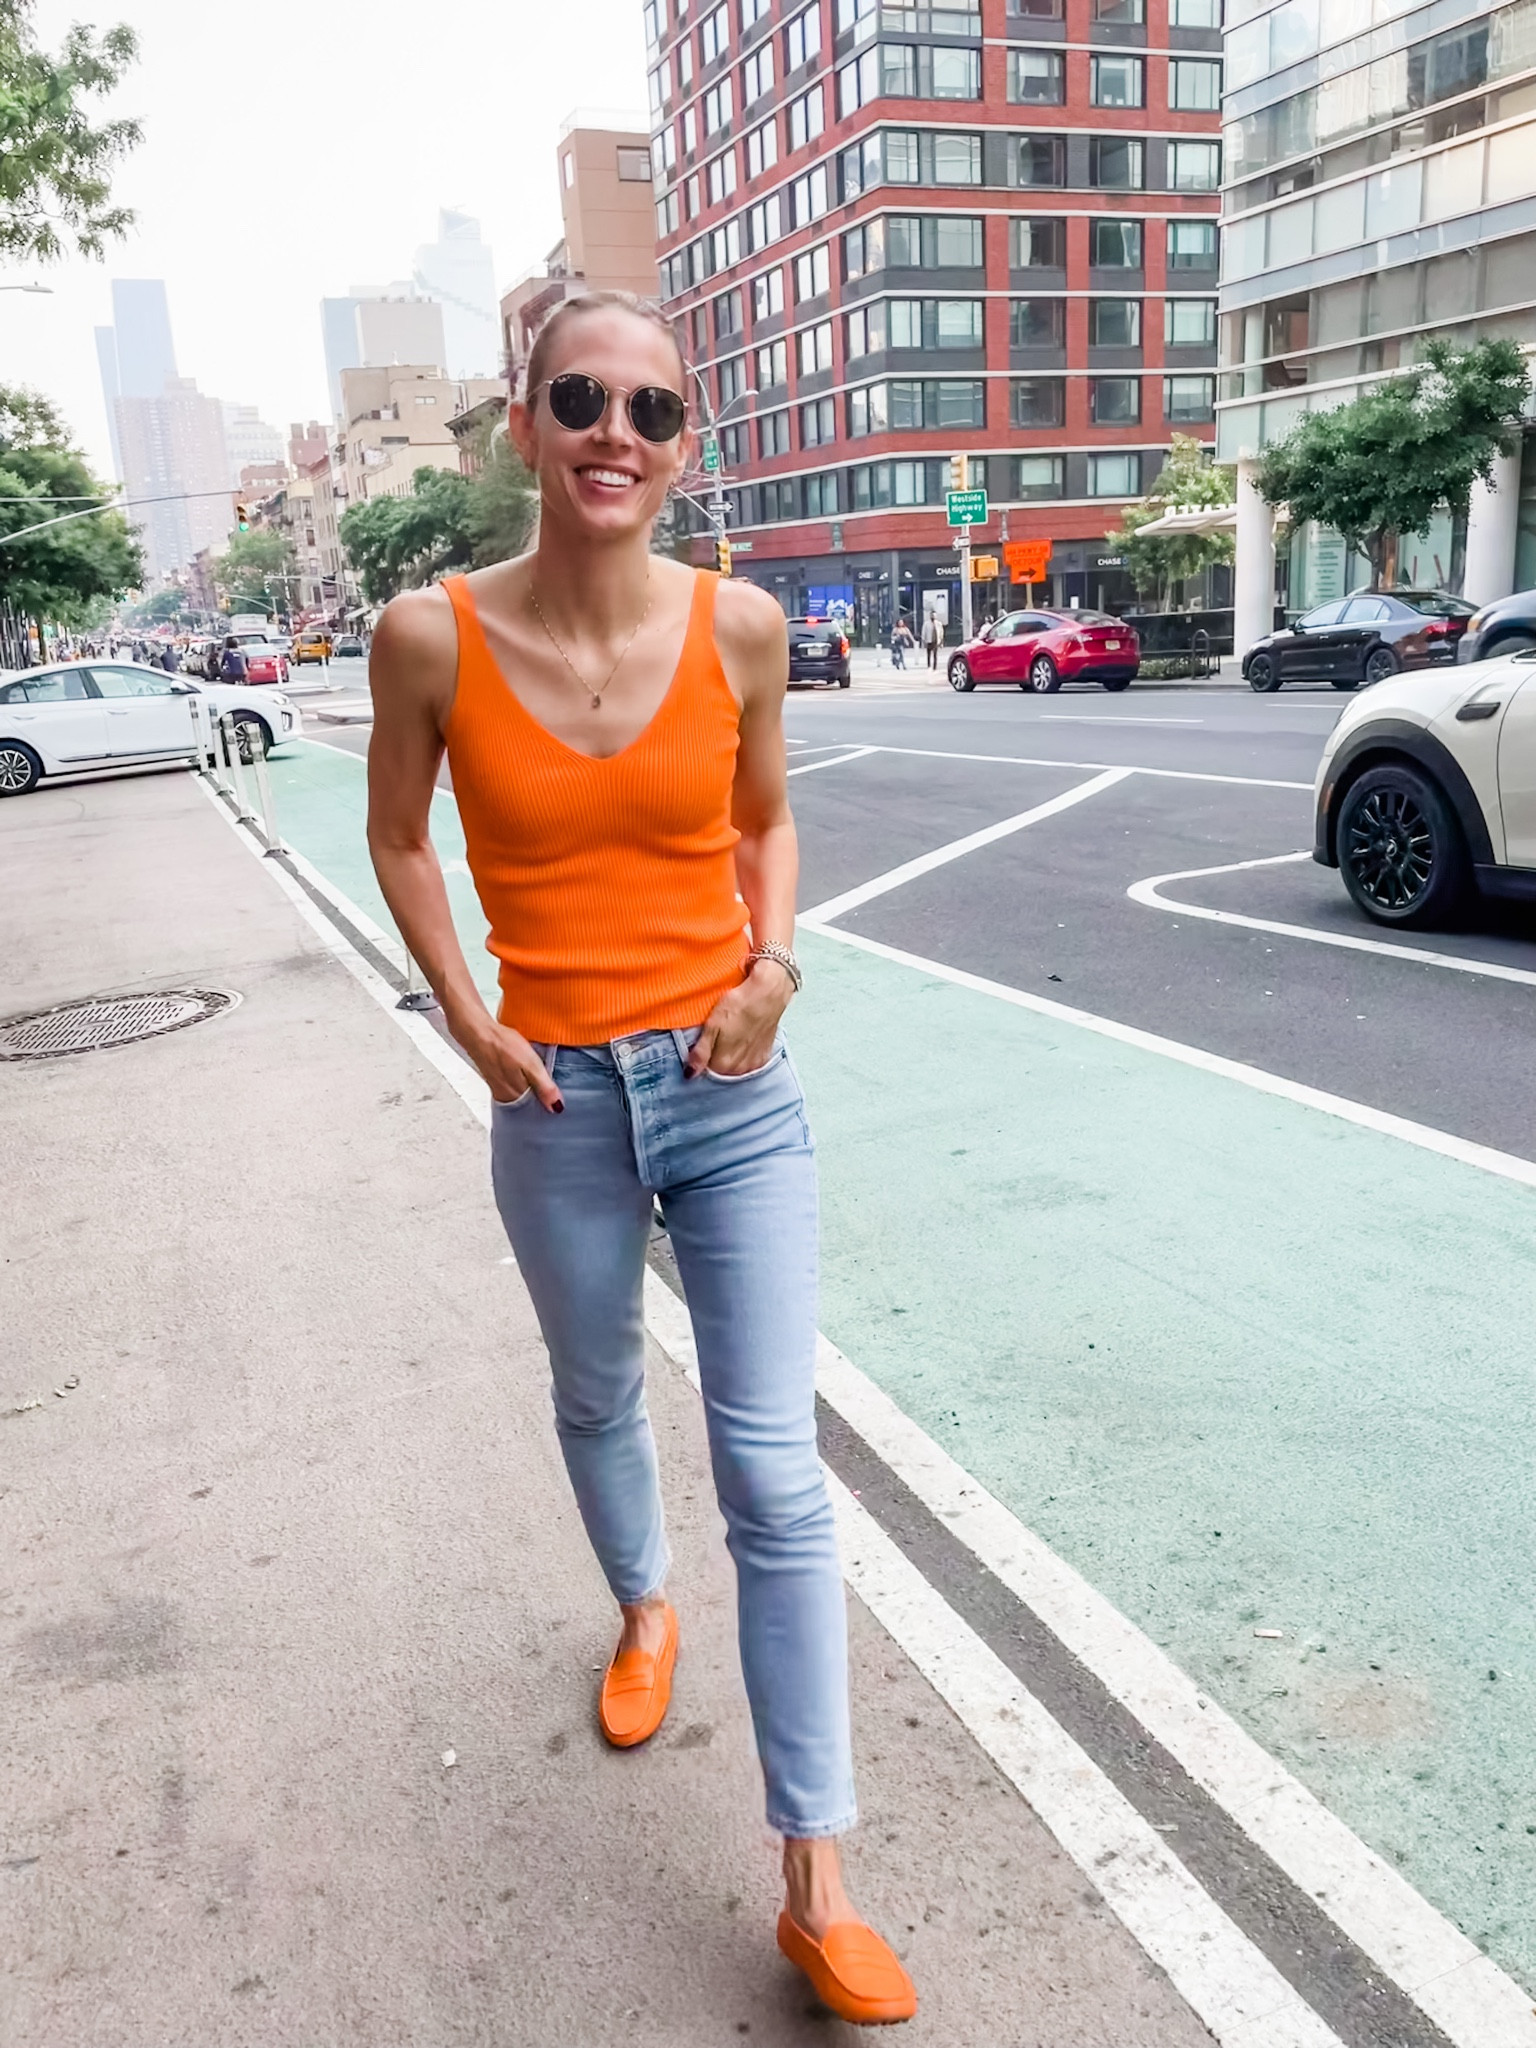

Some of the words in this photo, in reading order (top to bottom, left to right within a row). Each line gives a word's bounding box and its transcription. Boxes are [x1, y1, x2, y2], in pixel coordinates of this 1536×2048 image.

[951, 493, 982, 503] Westside
[951, 504, 983, 514] Highway
[1097, 557, 1121, 566] CHASE
[936, 567, 960, 576] CHASE
